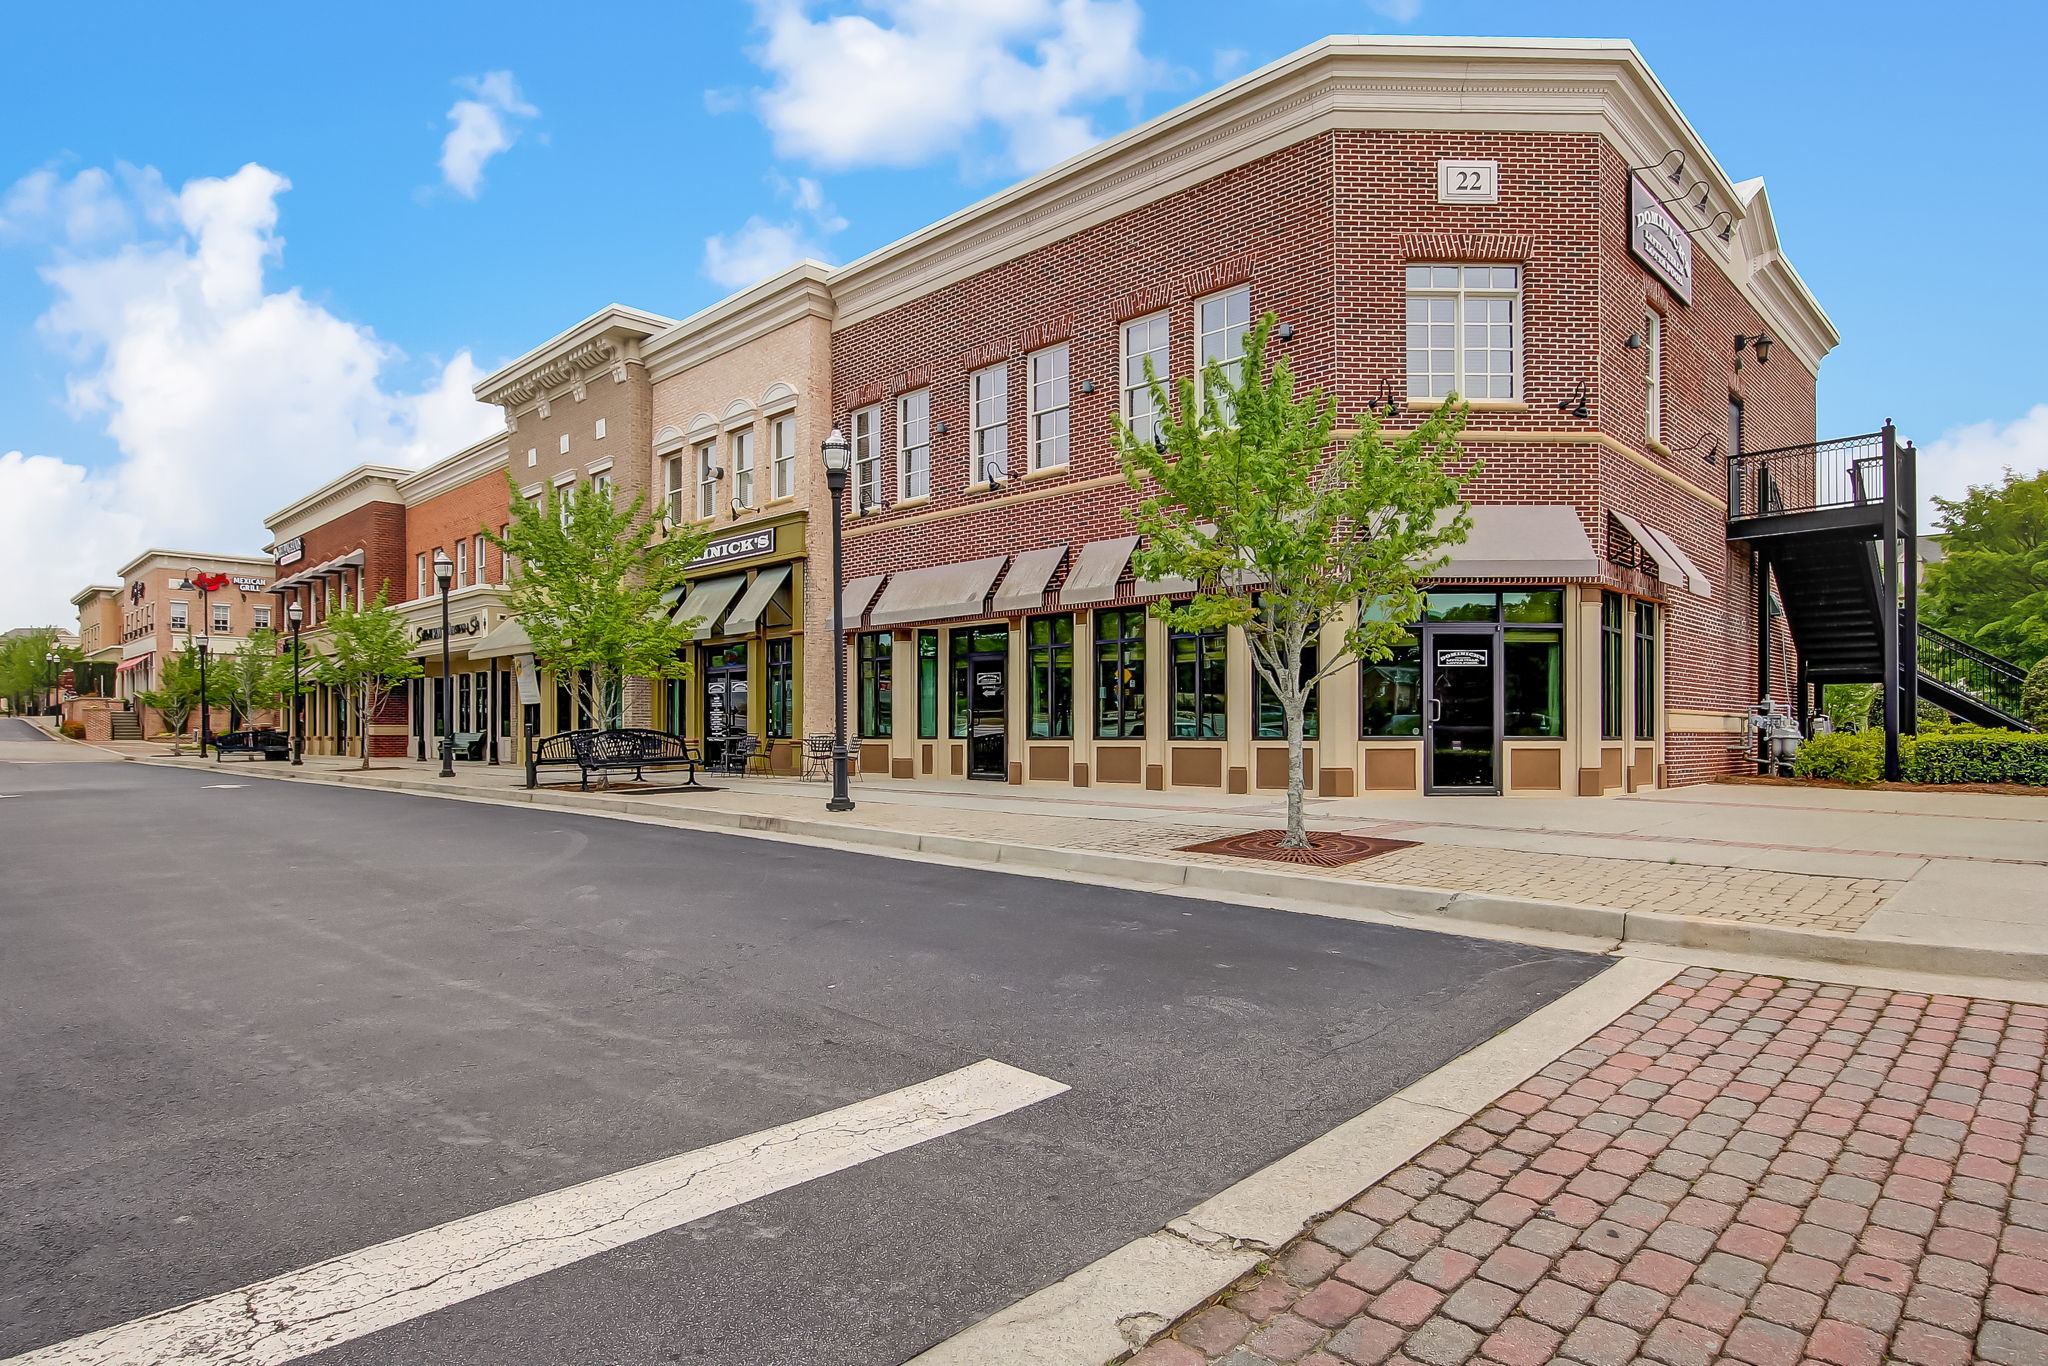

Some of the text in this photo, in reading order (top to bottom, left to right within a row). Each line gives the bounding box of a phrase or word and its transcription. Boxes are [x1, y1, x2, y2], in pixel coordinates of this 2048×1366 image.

[1456, 171, 1482, 190] 22
[690, 535, 770, 562] INICK'S
[233, 577, 266, 586] MEXICAN
